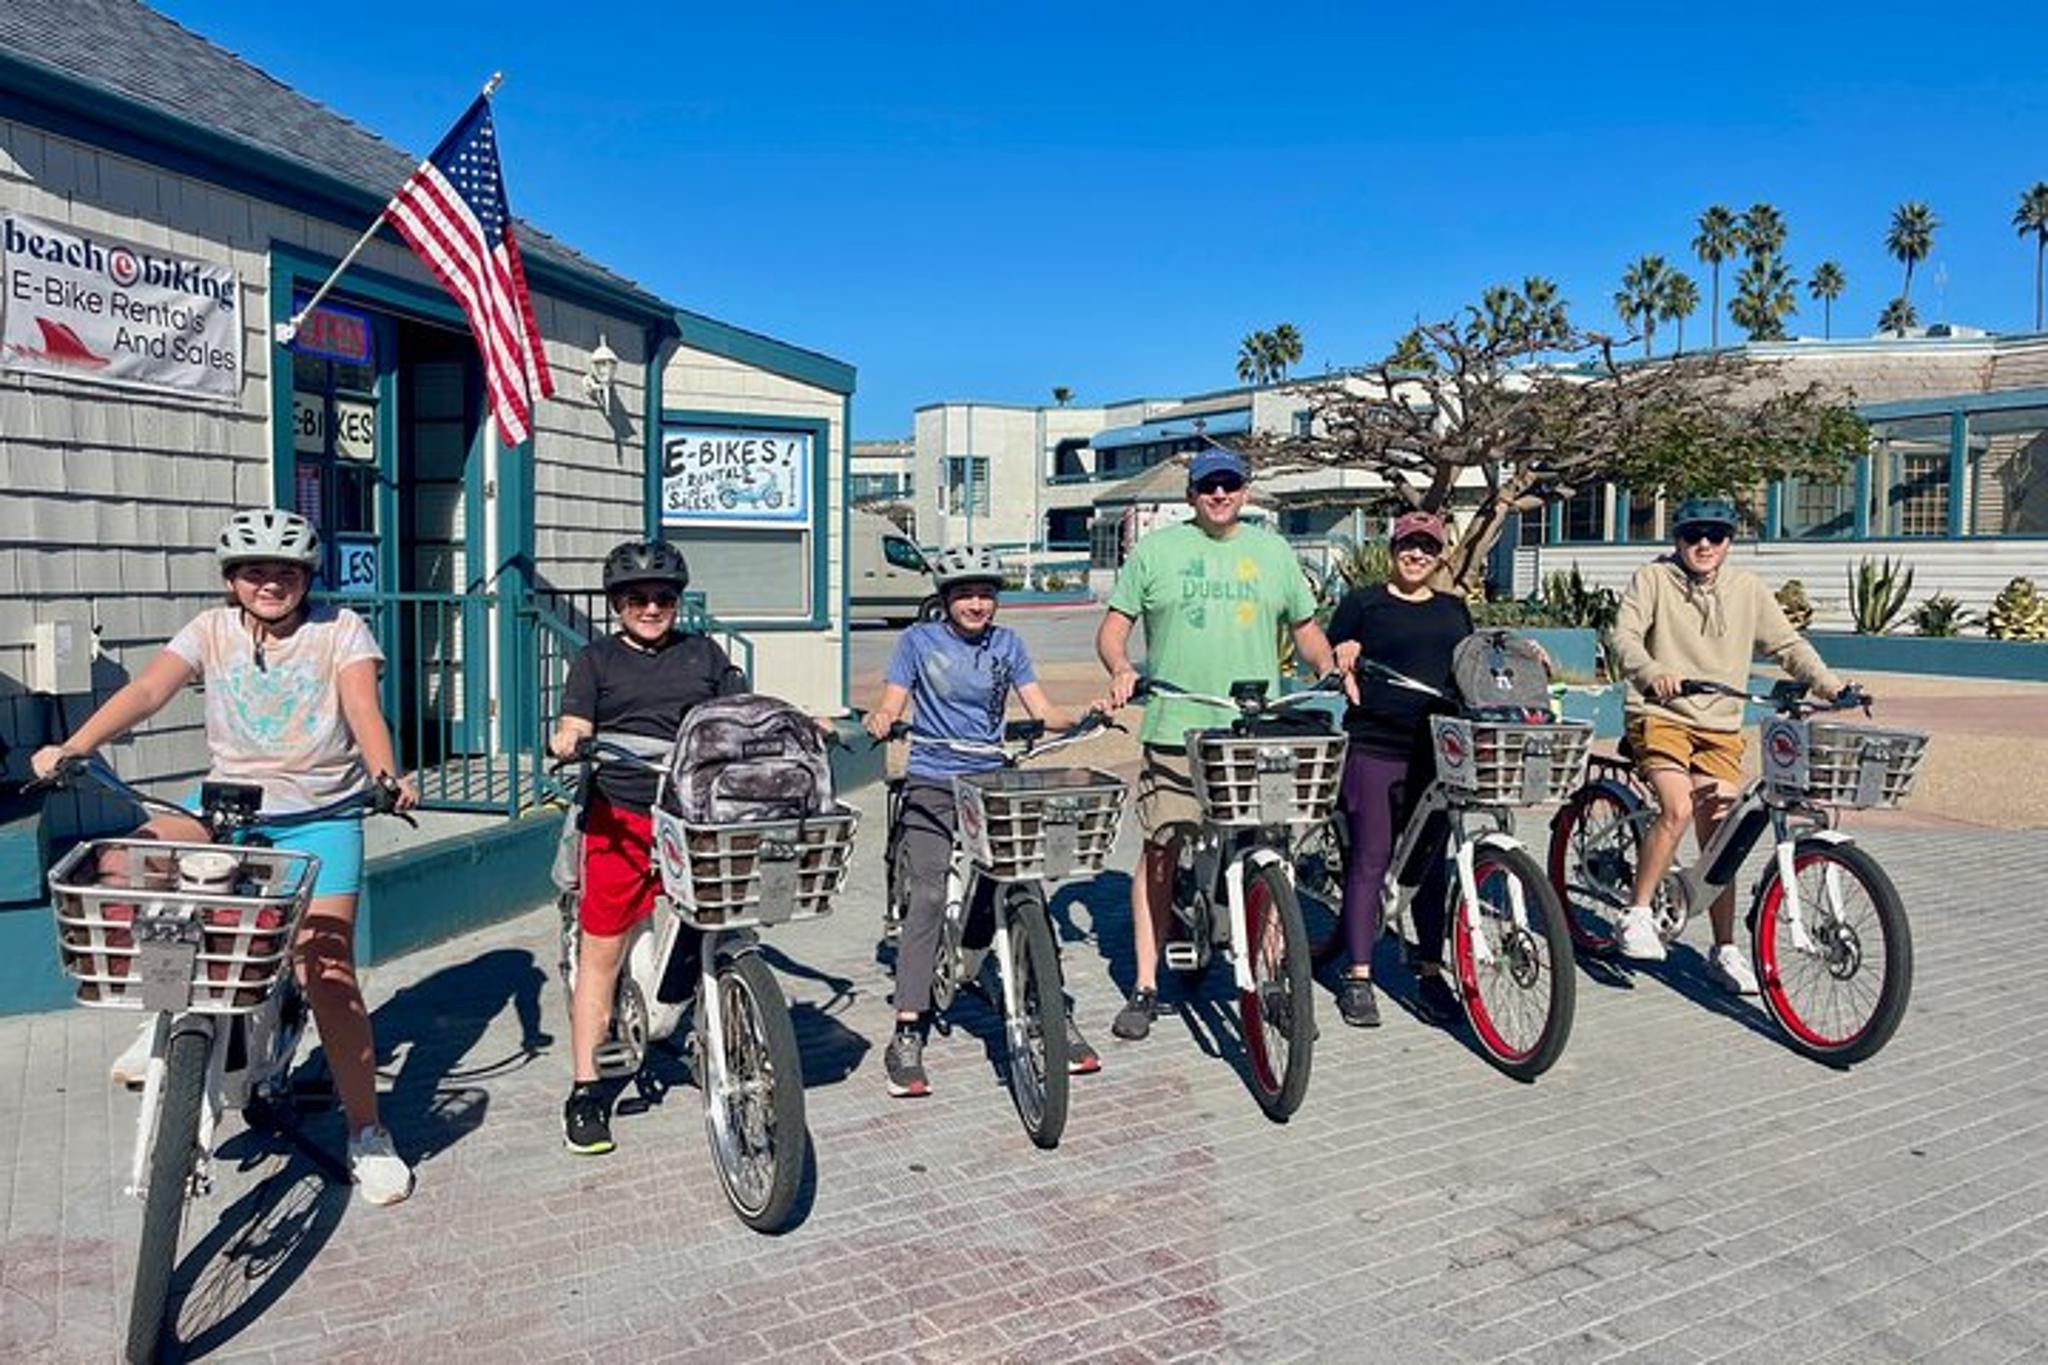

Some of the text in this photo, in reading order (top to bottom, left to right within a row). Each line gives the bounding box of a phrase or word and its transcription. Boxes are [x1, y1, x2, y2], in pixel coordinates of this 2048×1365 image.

[5, 219, 103, 272] beach
[143, 256, 234, 311] biking
[13, 270, 206, 333] E-Bike Rentals
[113, 327, 236, 371] And Sales
[1182, 578, 1258, 599] DUBLIN
